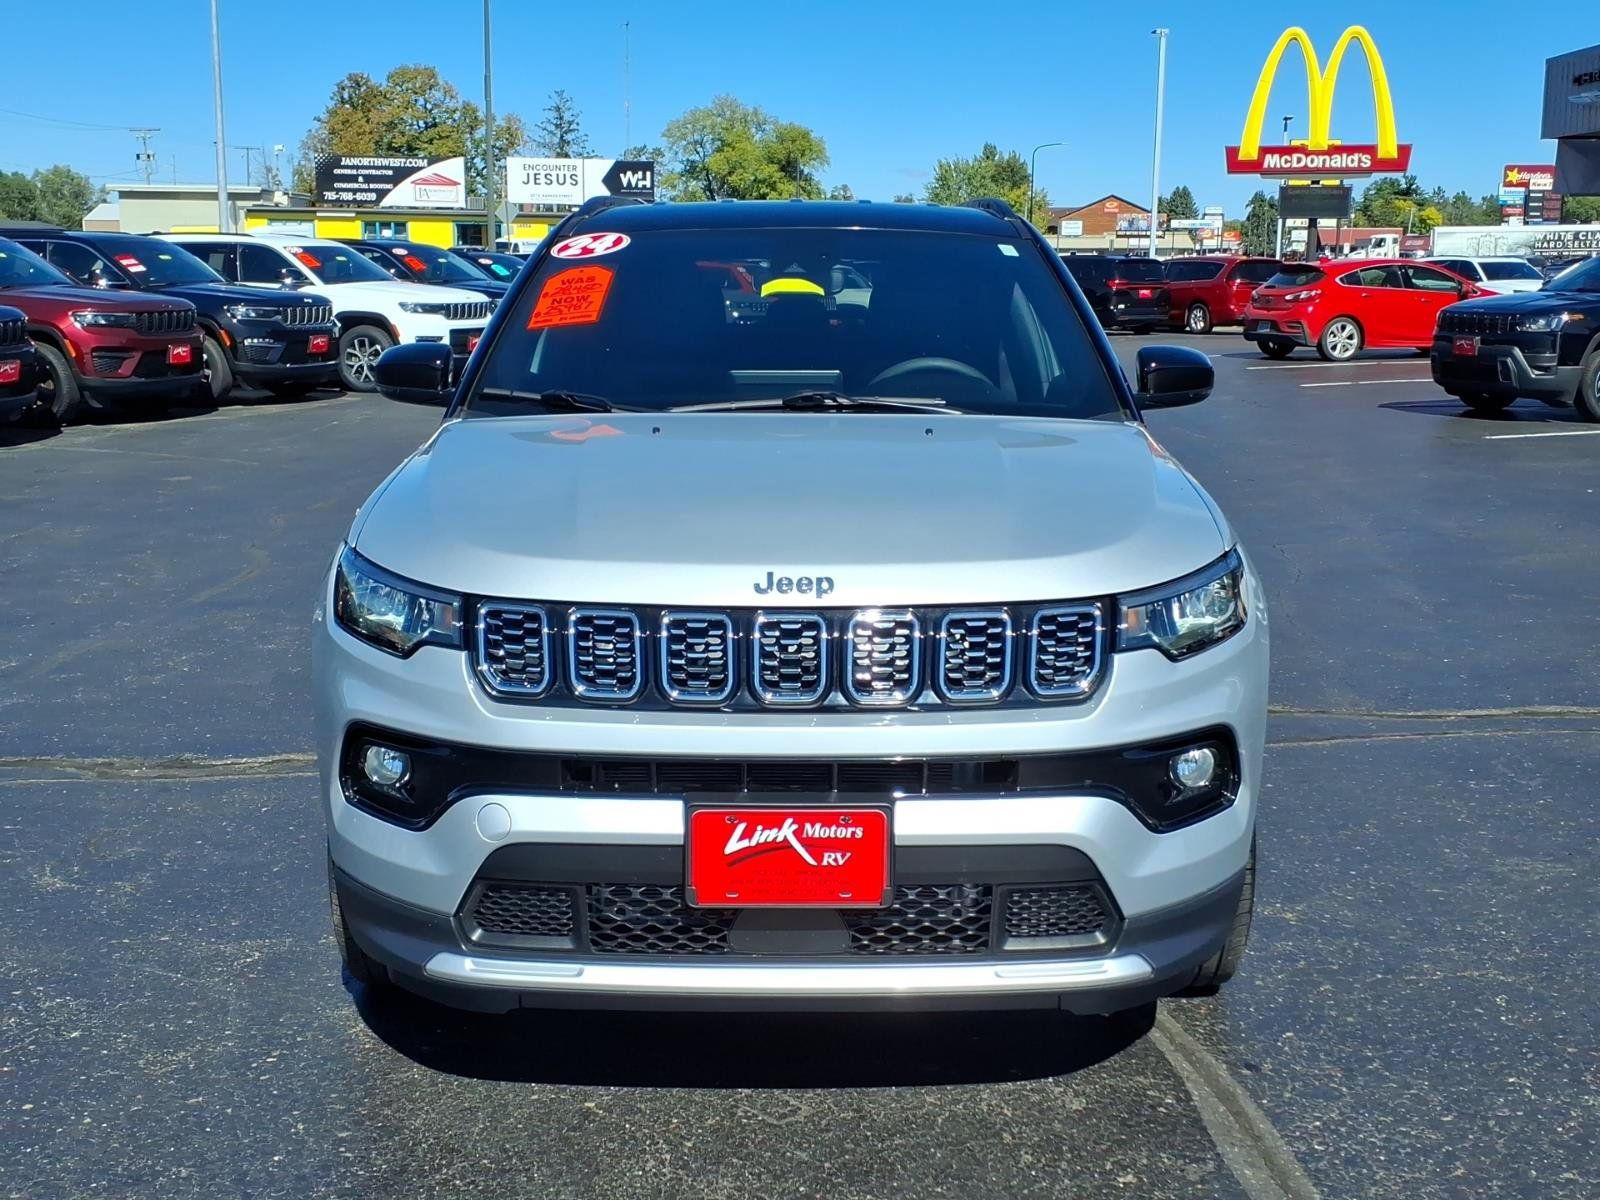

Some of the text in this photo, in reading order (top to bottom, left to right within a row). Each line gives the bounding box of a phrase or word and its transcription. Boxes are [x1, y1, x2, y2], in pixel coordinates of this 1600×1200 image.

[340, 157, 428, 168] JANORTHWEST.COM
[1263, 152, 1372, 169] McDonald's
[523, 163, 578, 172] ENCOUNTER
[521, 172, 579, 187] JESUS
[620, 170, 651, 189] WH
[323, 191, 377, 201] 715-768-6039
[1535, 231, 1574, 241] WHITE
[1535, 240, 1563, 249] HARD
[561, 276, 596, 286] WAS
[551, 294, 591, 305] NOW
[753, 571, 835, 599] Jeep
[724, 817, 864, 866] Link Motors
[821, 852, 852, 866] RV
